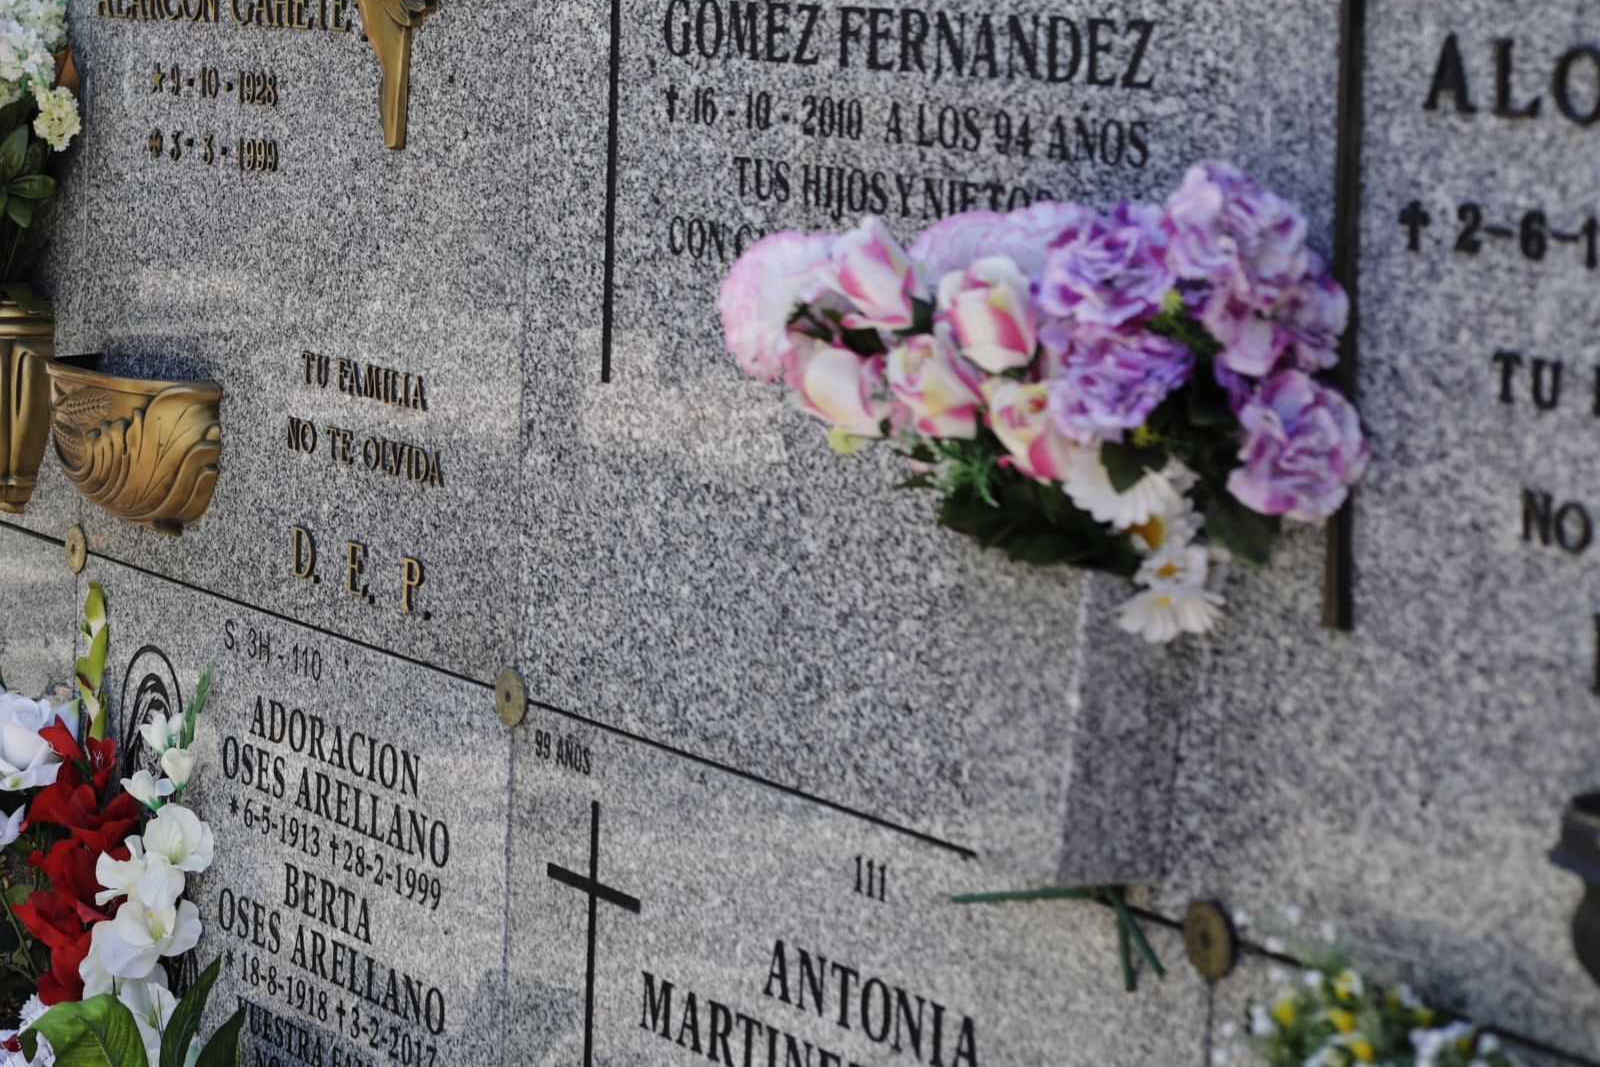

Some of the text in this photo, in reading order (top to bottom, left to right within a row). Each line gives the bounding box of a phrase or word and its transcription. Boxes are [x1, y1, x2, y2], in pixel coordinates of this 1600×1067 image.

[838, 6, 1156, 90] FERNANDEZ
[885, 101, 902, 144] A
[917, 103, 981, 153] LOS
[994, 110, 1032, 159] 94
[733, 156, 791, 204] TUS
[803, 164, 888, 222] HIJOS
[897, 174, 914, 218] Y
[669, 215, 725, 263] CON
[301, 350, 428, 412] TU FAMILIA
[1492, 350, 1564, 410] TU
[287, 416, 444, 487] NO TE OLVIDA
[1521, 487, 1593, 554] NO
[290, 526, 431, 622] D. E. P.
[247, 627, 270, 664] 3H
[292, 641, 322, 682] 110
[250, 695, 420, 799] ADORACION
[535, 728, 551, 760] 99
[222, 735, 450, 869] OSES ARELLANO
[284, 862, 372, 945] BERTA
[343, 841, 442, 912] 28-2-1999
[218, 887, 446, 1036] OSES ARELLANO
[763, 939, 978, 1067] ANTONIA
